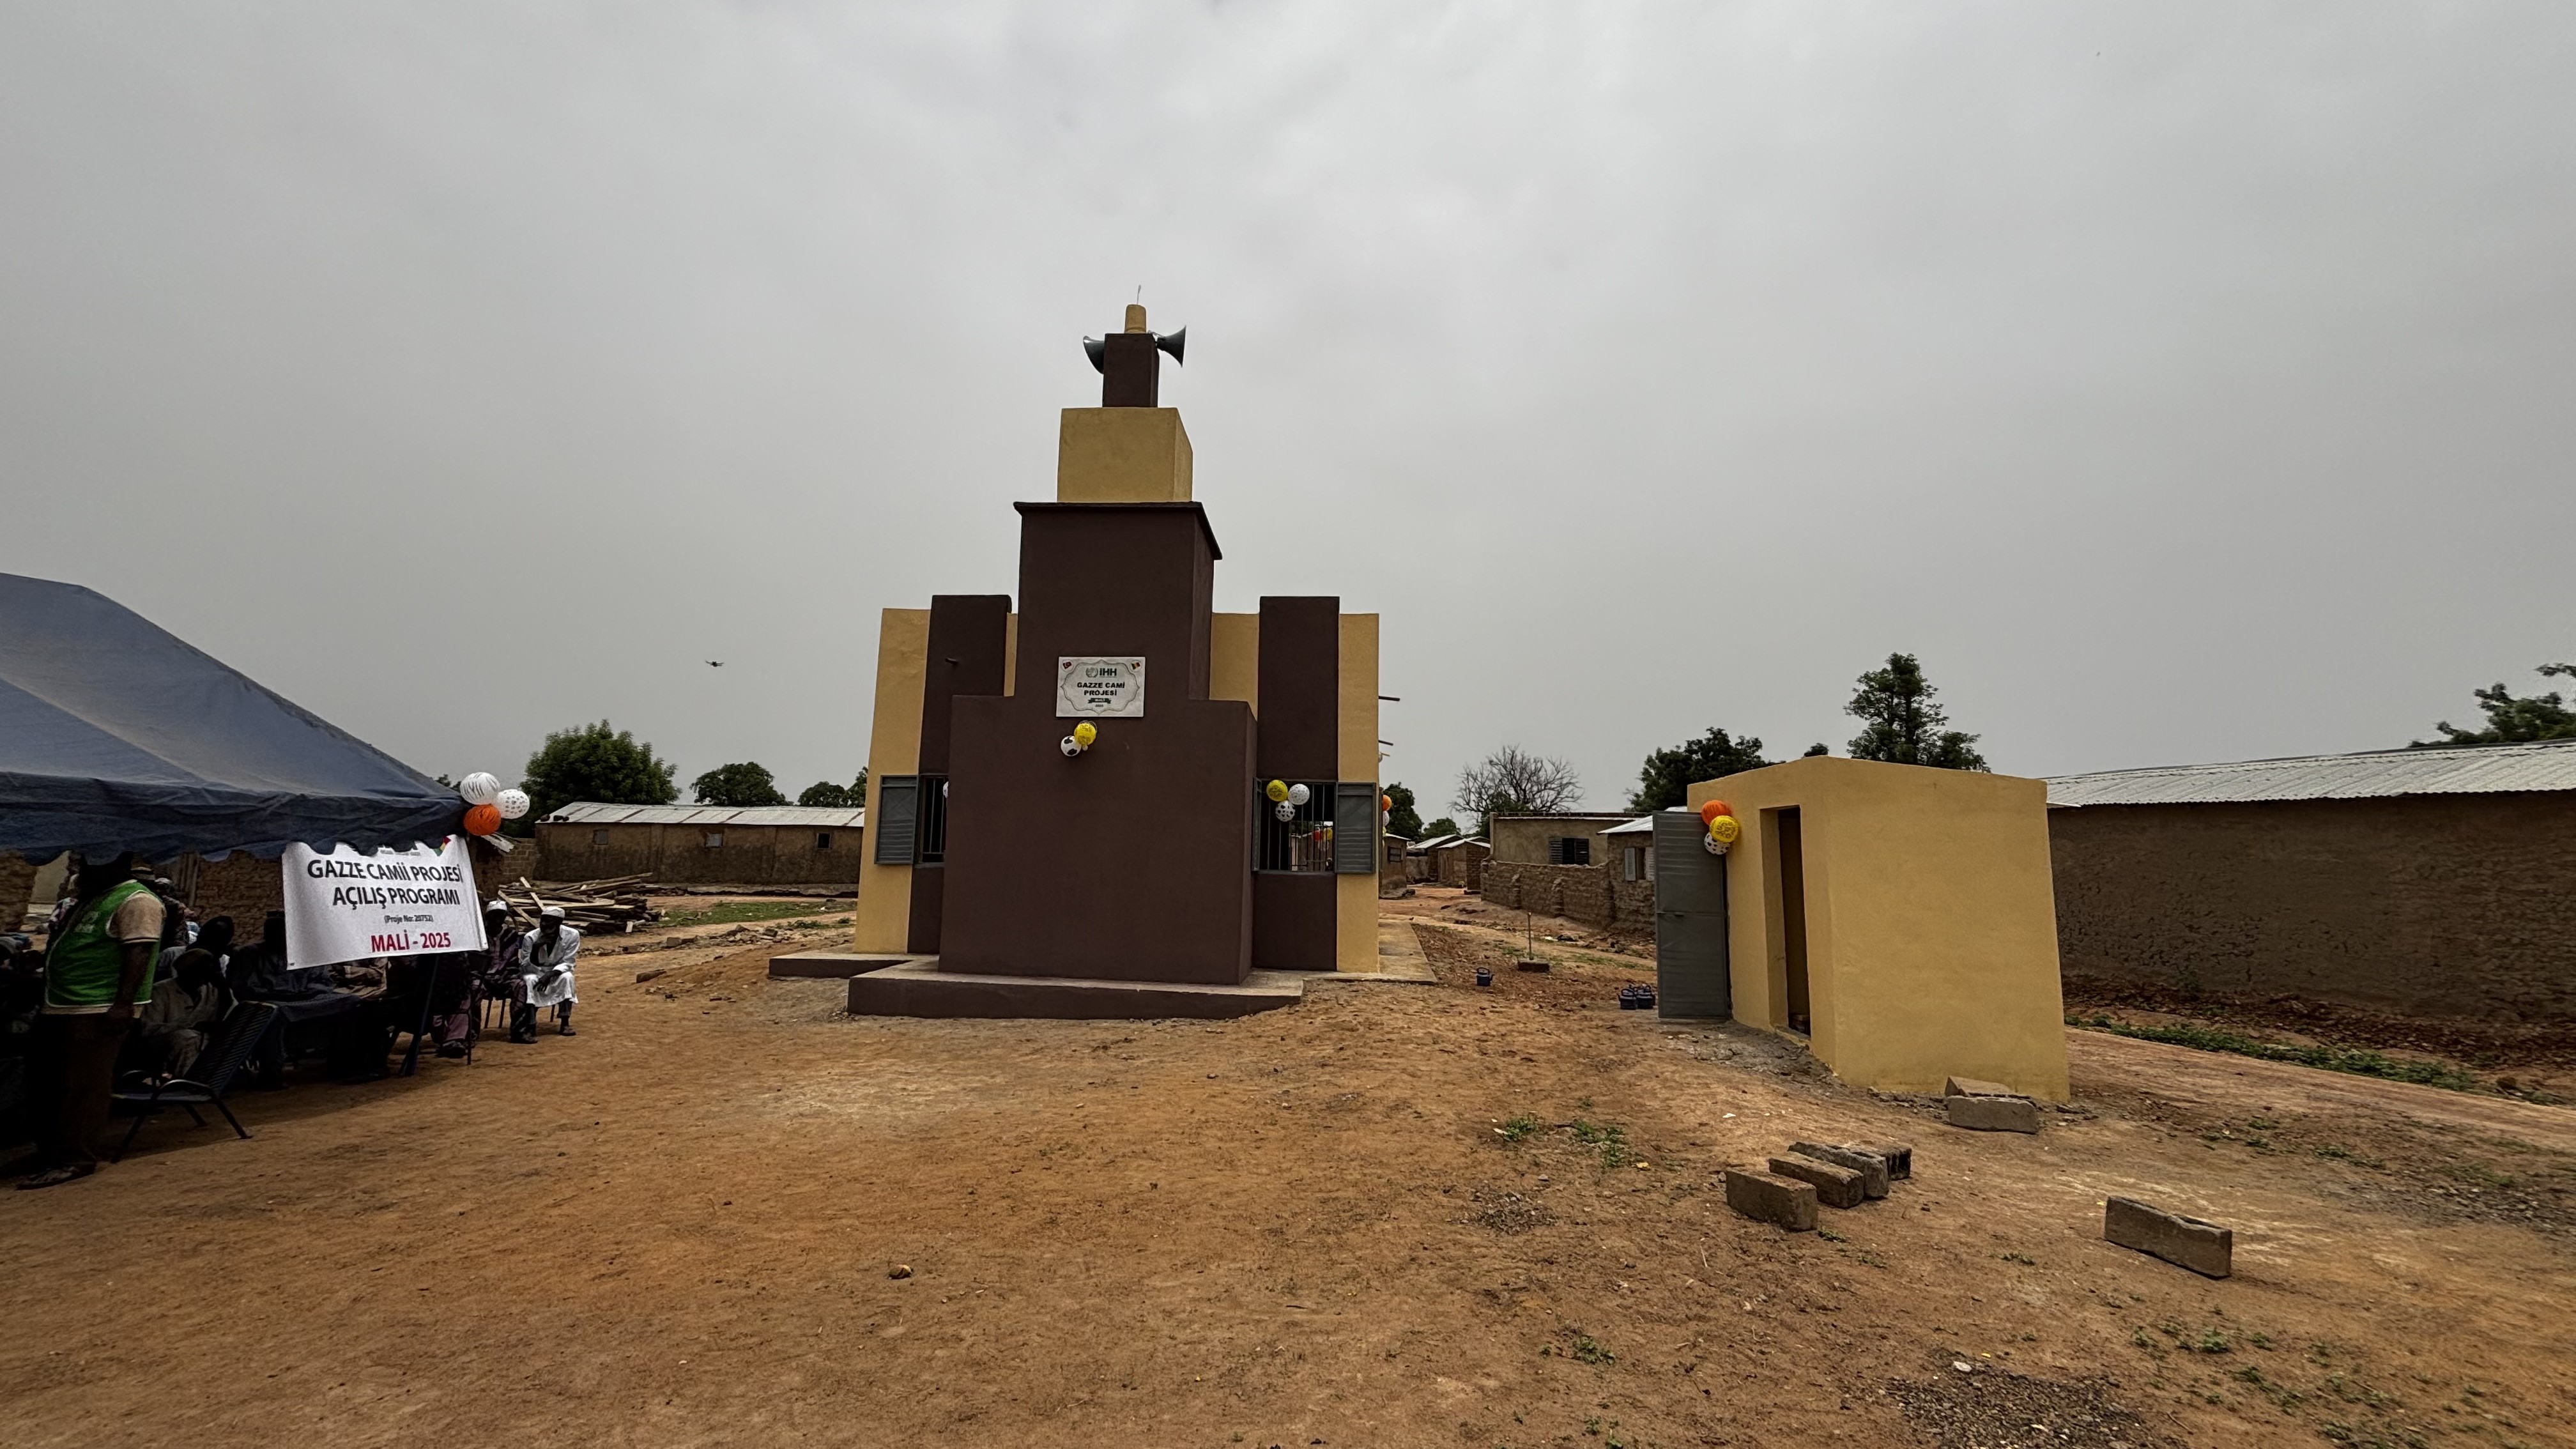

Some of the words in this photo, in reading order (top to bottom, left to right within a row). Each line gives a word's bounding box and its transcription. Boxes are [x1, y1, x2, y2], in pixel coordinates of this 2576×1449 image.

[307, 859, 367, 879] GAZZE
[367, 862, 411, 881] CAMİİ
[410, 864, 463, 883] PROJESİ
[332, 887, 387, 910] AÇILIŞ
[387, 887, 461, 905] PROGRAMI
[371, 929, 410, 953] MALİ
[420, 932, 451, 949] 2025
